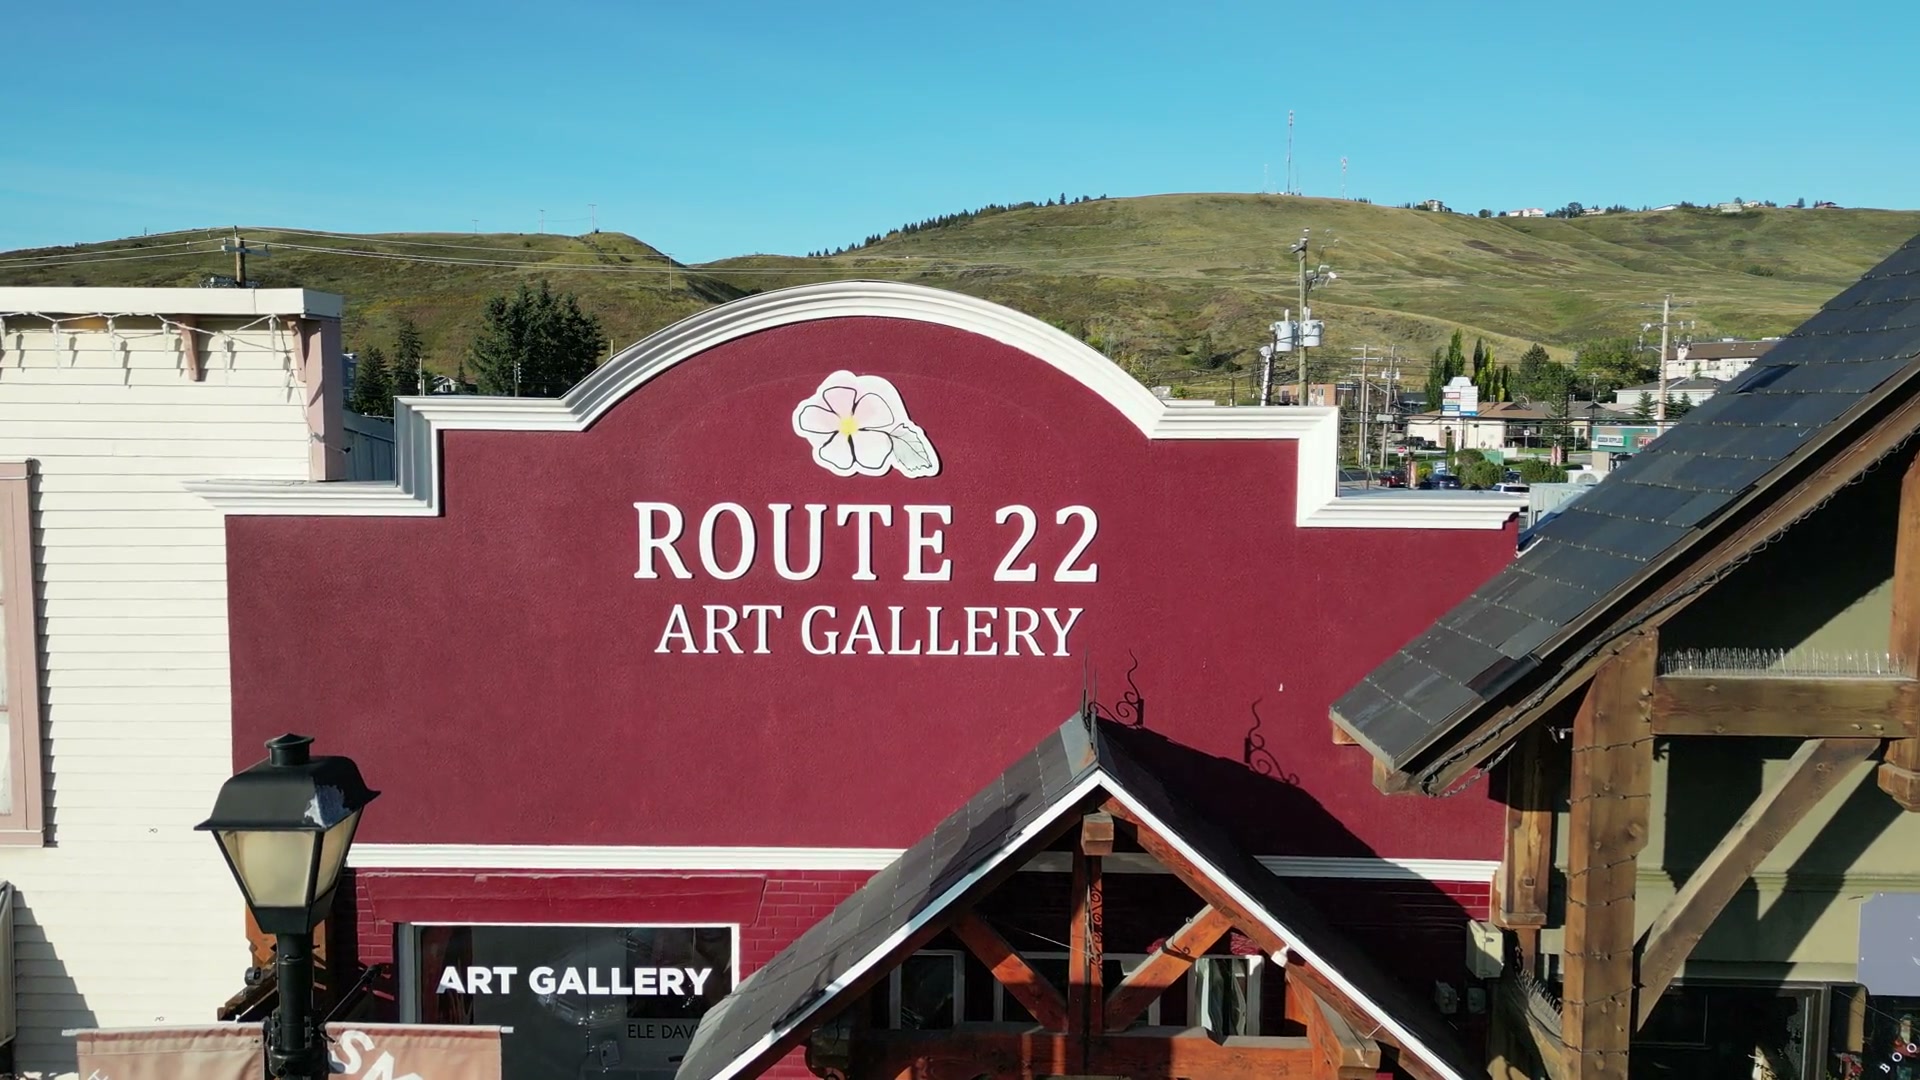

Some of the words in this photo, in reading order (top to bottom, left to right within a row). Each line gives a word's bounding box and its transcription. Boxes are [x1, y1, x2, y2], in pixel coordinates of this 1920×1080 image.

[633, 501, 952, 581] ROUTE
[993, 504, 1098, 582] 22
[654, 604, 782, 654] ART
[801, 605, 1084, 657] GALLERY
[436, 966, 518, 994] ART
[528, 966, 713, 996] GALLERY
[627, 1024, 655, 1039] ELE
